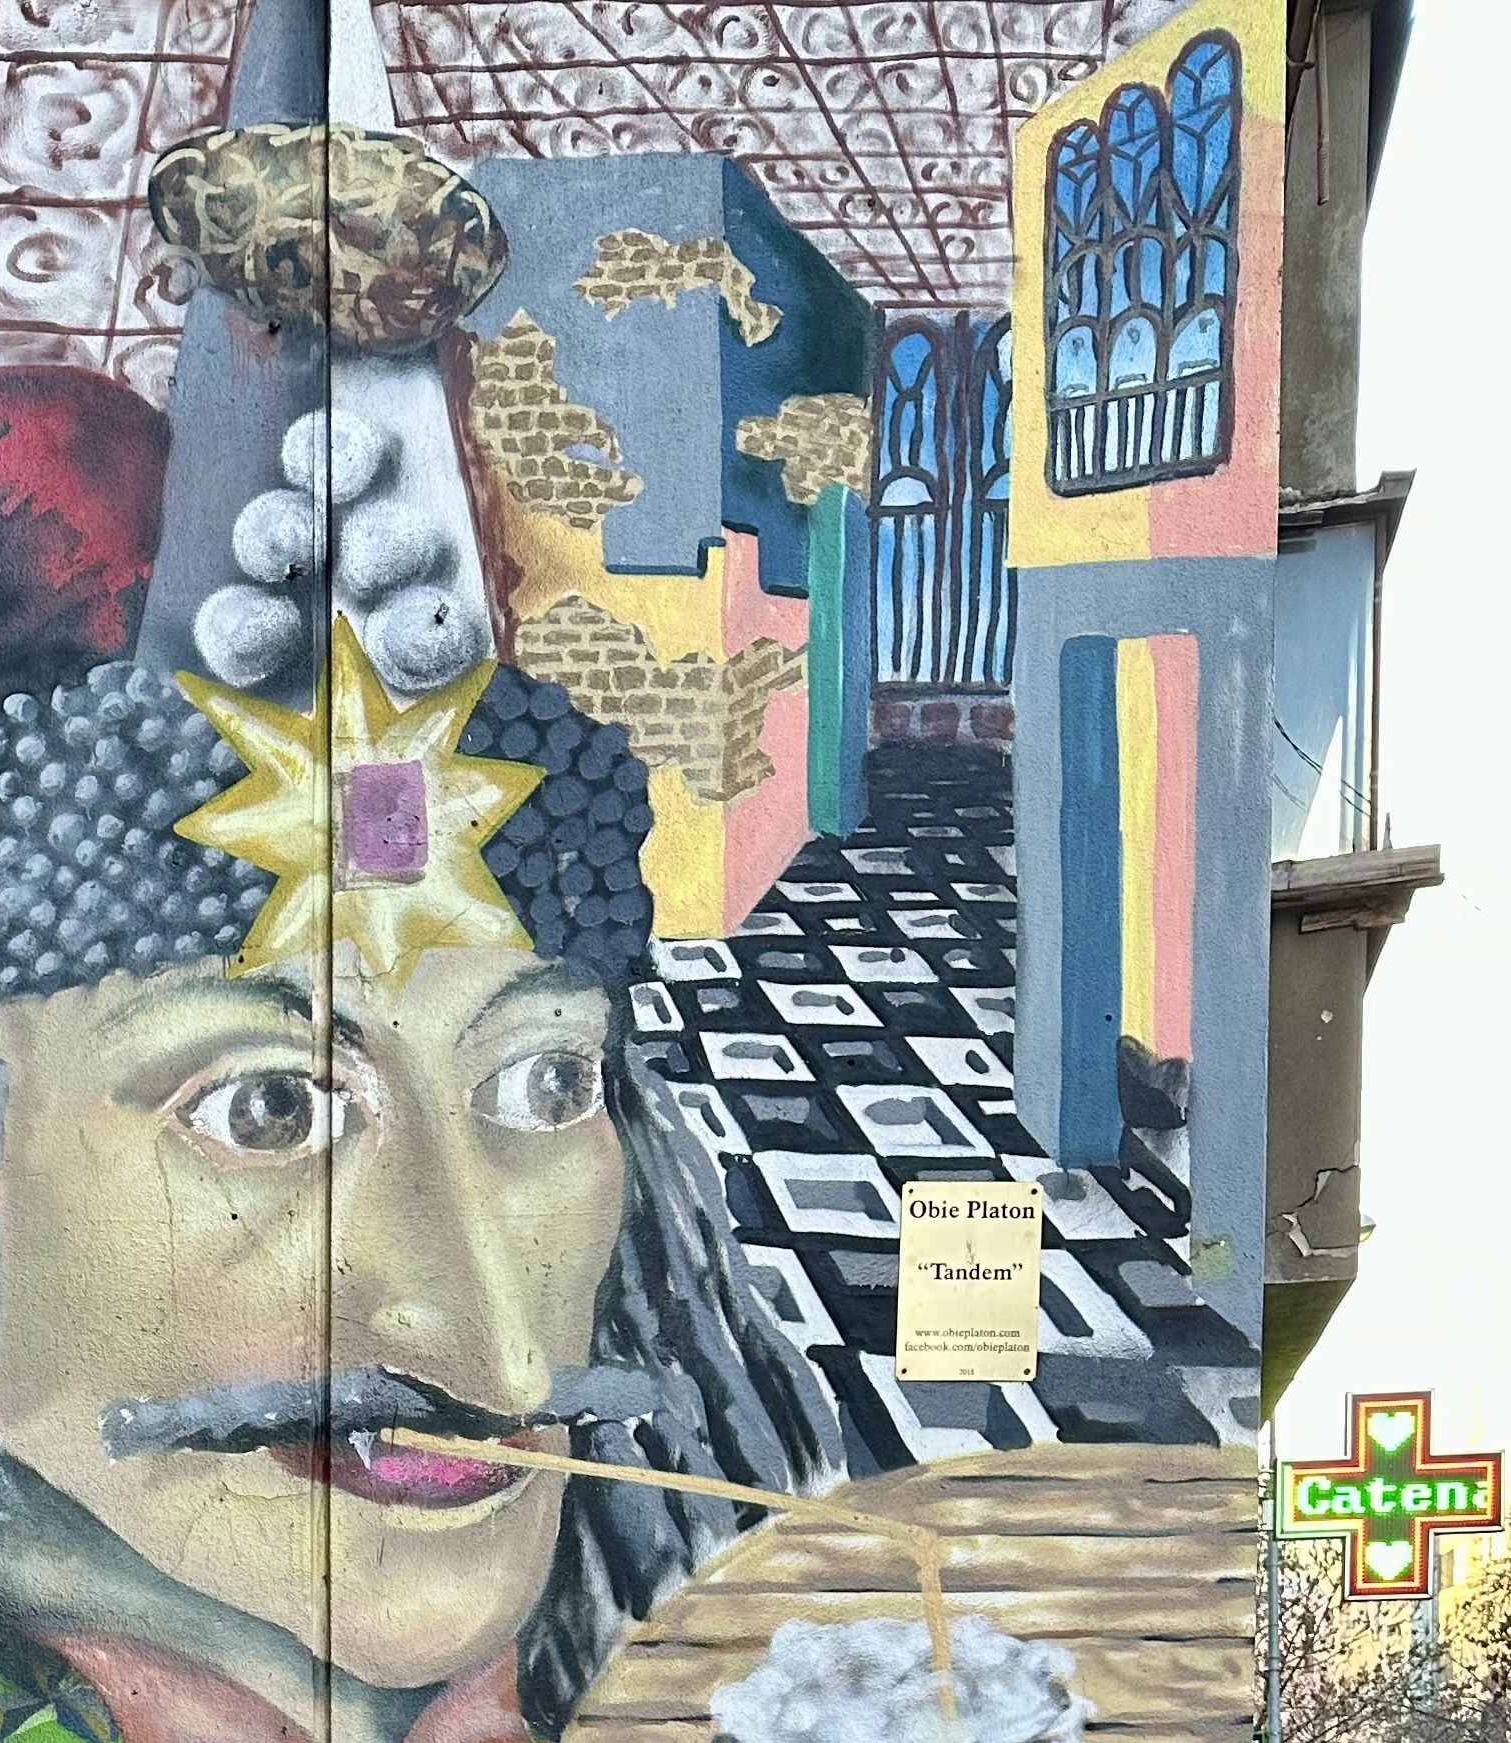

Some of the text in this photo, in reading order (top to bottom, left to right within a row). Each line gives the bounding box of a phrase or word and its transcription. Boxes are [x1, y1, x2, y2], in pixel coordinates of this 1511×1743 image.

[910, 1200, 1036, 1219] Obie Platon
[918, 1263, 1023, 1281] “Tandem”
[915, 1328, 1020, 1340] www.obieplaton.com
[904, 1342, 1030, 1354] facebook.com/obieplaton
